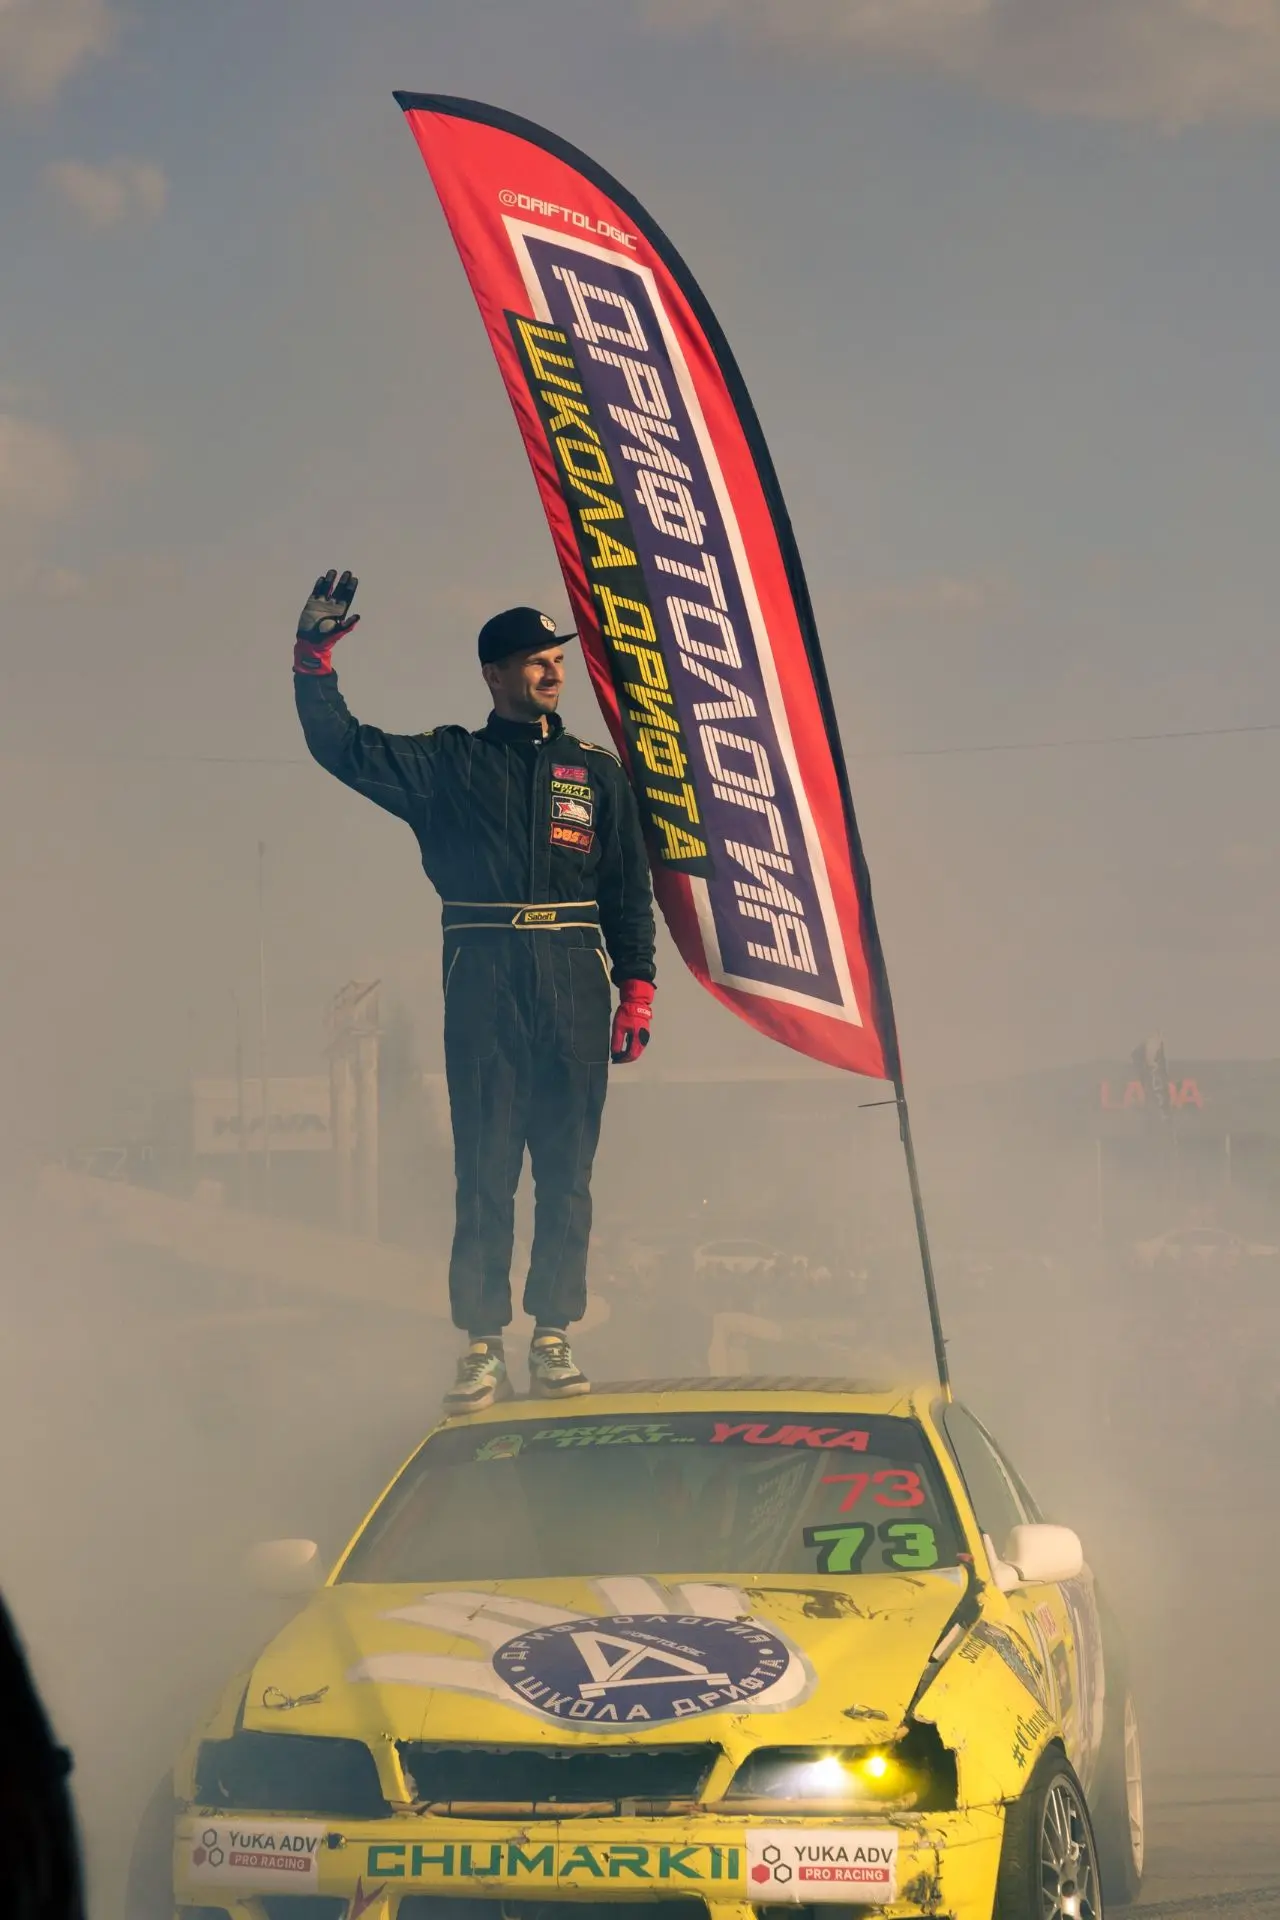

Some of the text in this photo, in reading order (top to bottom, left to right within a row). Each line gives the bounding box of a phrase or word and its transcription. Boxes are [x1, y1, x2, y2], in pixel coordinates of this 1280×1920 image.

[499, 189, 638, 251] @DRIFTOLOGIC
[516, 319, 708, 861] ШКОЛА ДРИФТА
[551, 264, 820, 977] ДРИФТОЛОГИЯ
[1101, 1078, 1203, 1110] LAA
[533, 1423, 672, 1439] DRIFT
[709, 1422, 871, 1452] YUKA
[819, 1469, 926, 1513] 73
[805, 1520, 939, 1574] 73
[501, 1615, 773, 1660] ДРИФТОЛОГИЯ
[513, 1659, 785, 1722] ШКОЛА ДРИФТА
[229, 1831, 317, 1853] YUKA ADV
[794, 1846, 896, 1864] YUKA ADV
[234, 1854, 305, 1871] PRO RACING
[805, 1868, 884, 1882] PRO RACING
